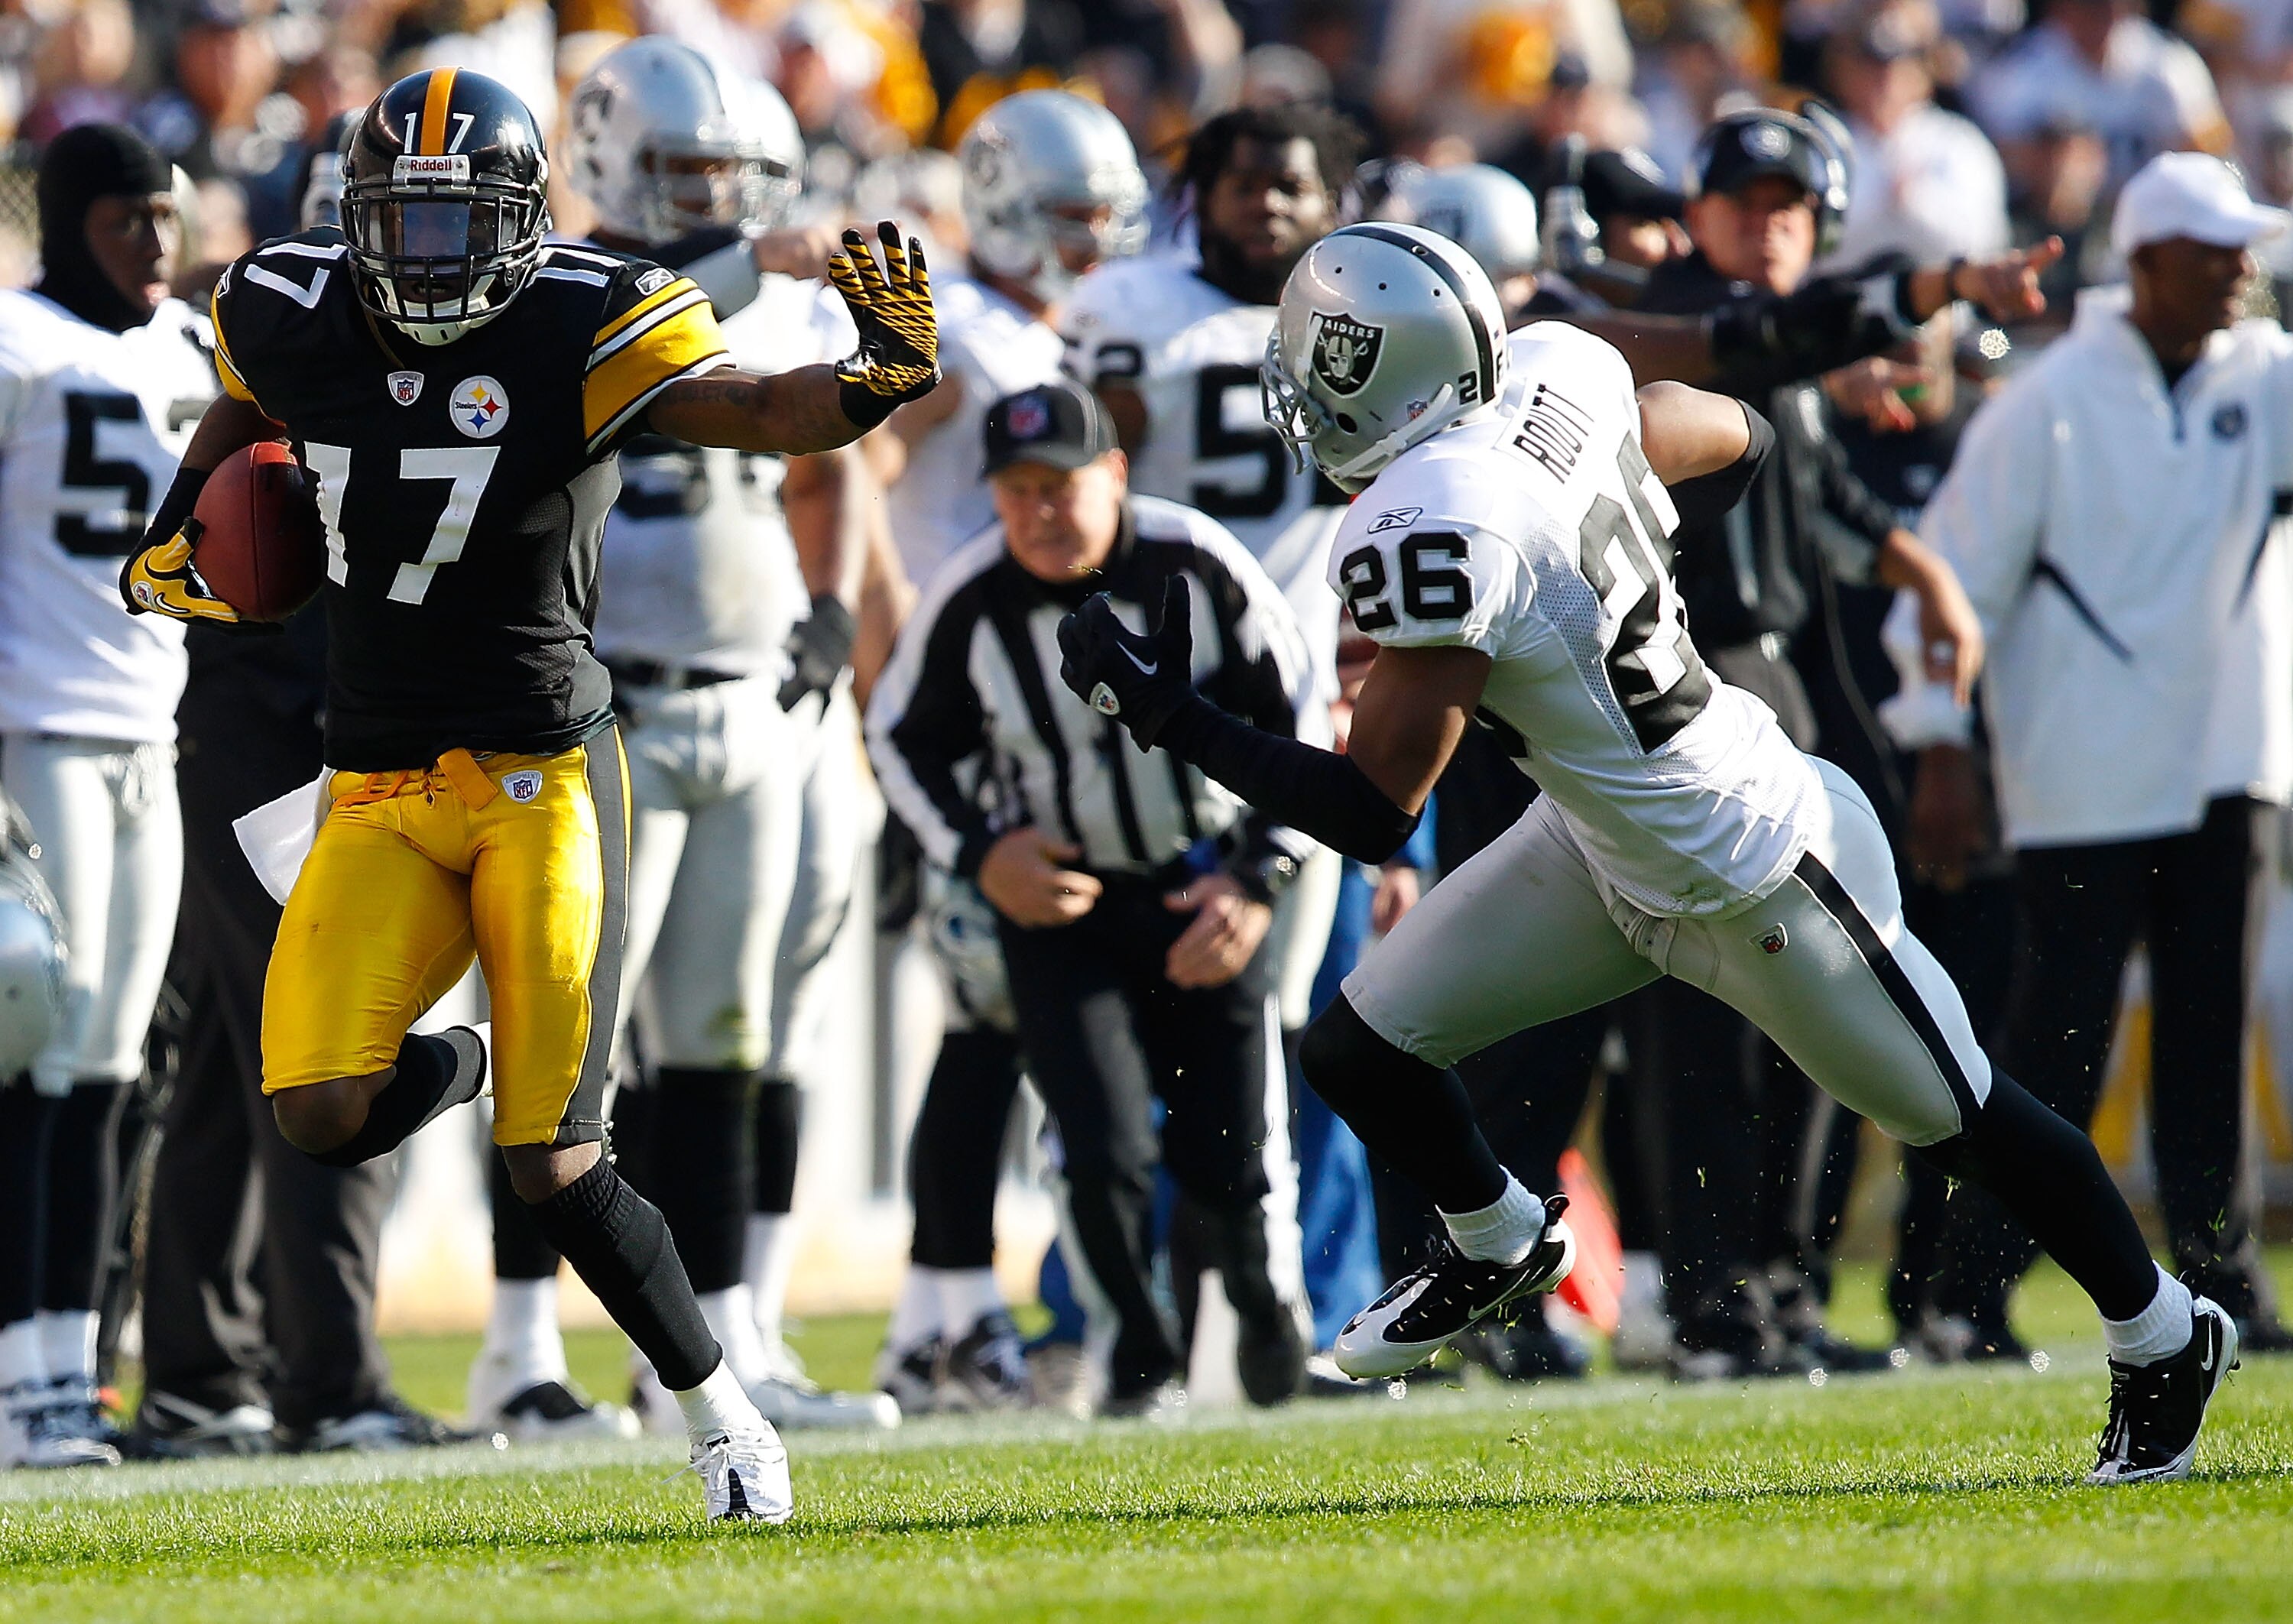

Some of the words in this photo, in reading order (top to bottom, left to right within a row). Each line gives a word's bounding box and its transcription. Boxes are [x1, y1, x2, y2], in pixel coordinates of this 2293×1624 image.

[404, 112, 475, 154] 17
[410, 157, 452, 171] Riddell
[1323, 319, 1376, 339] AIDERS
[455, 401, 478, 410] Steelers
[304, 440, 501, 605] 17
[1339, 531, 1475, 632] 26
[514, 784, 533, 797] NFL
